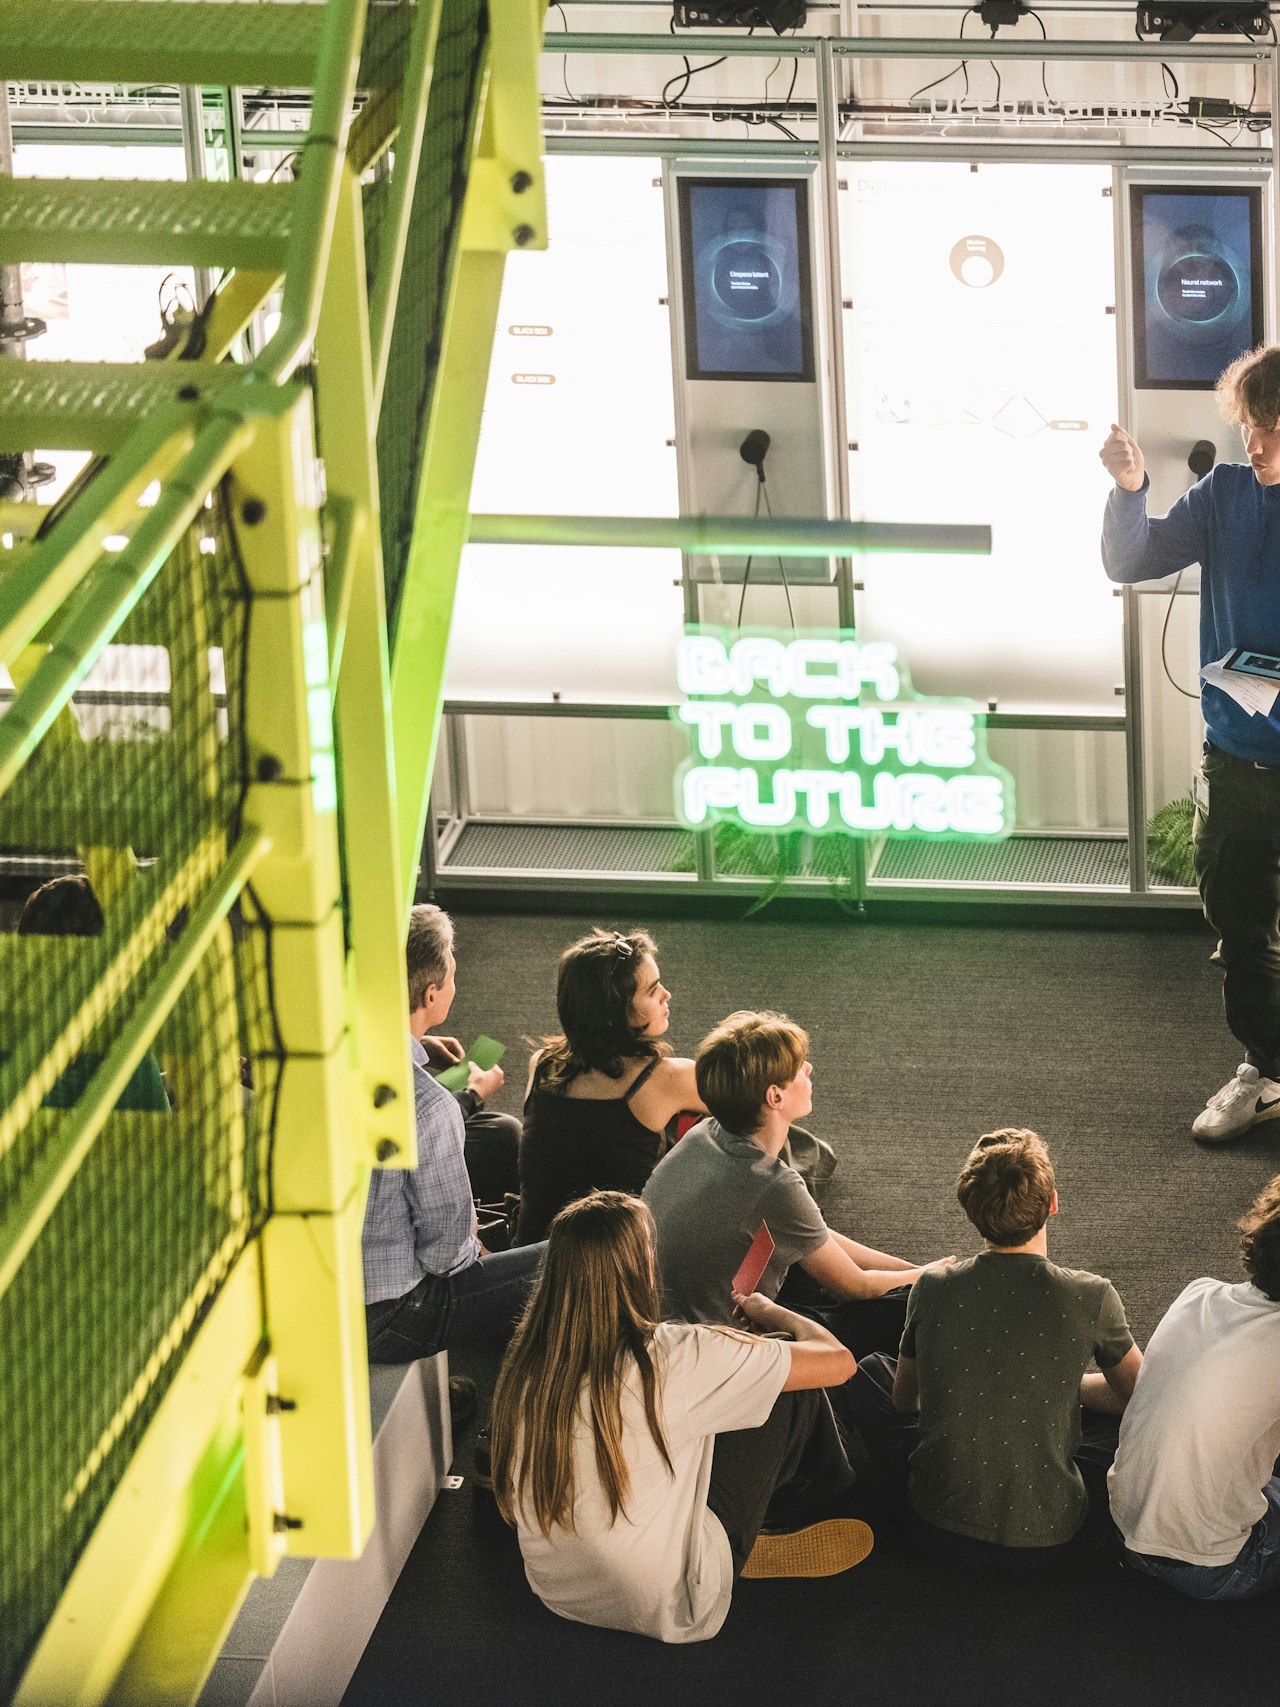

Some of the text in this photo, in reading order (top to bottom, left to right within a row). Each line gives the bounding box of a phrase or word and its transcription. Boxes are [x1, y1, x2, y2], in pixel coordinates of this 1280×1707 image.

[677, 636, 900, 702] BACK
[679, 701, 976, 768] TO THE
[684, 766, 1004, 834] FUTURE
